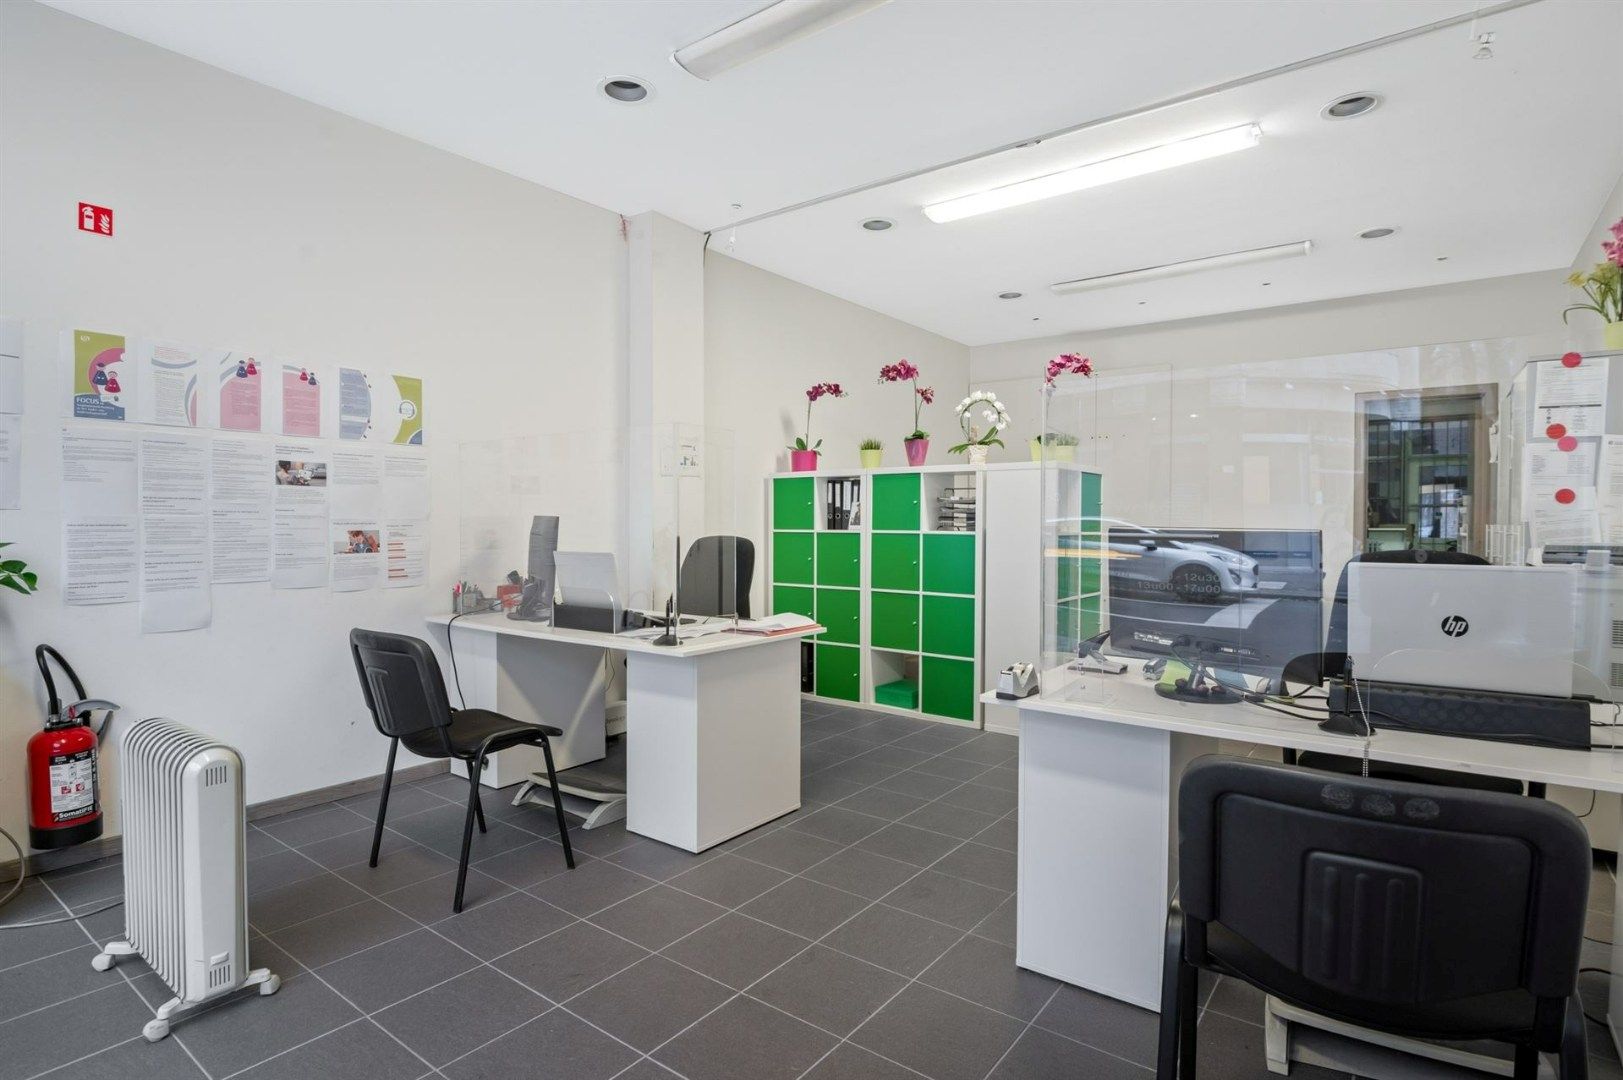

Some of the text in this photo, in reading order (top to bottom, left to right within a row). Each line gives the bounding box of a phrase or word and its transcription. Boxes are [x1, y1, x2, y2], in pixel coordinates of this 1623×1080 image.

[76, 397, 99, 405] FOCUS
[1137, 581, 1174, 591] 13u00
[1184, 583, 1221, 593] 17u00
[1444, 615, 1467, 638] hp
